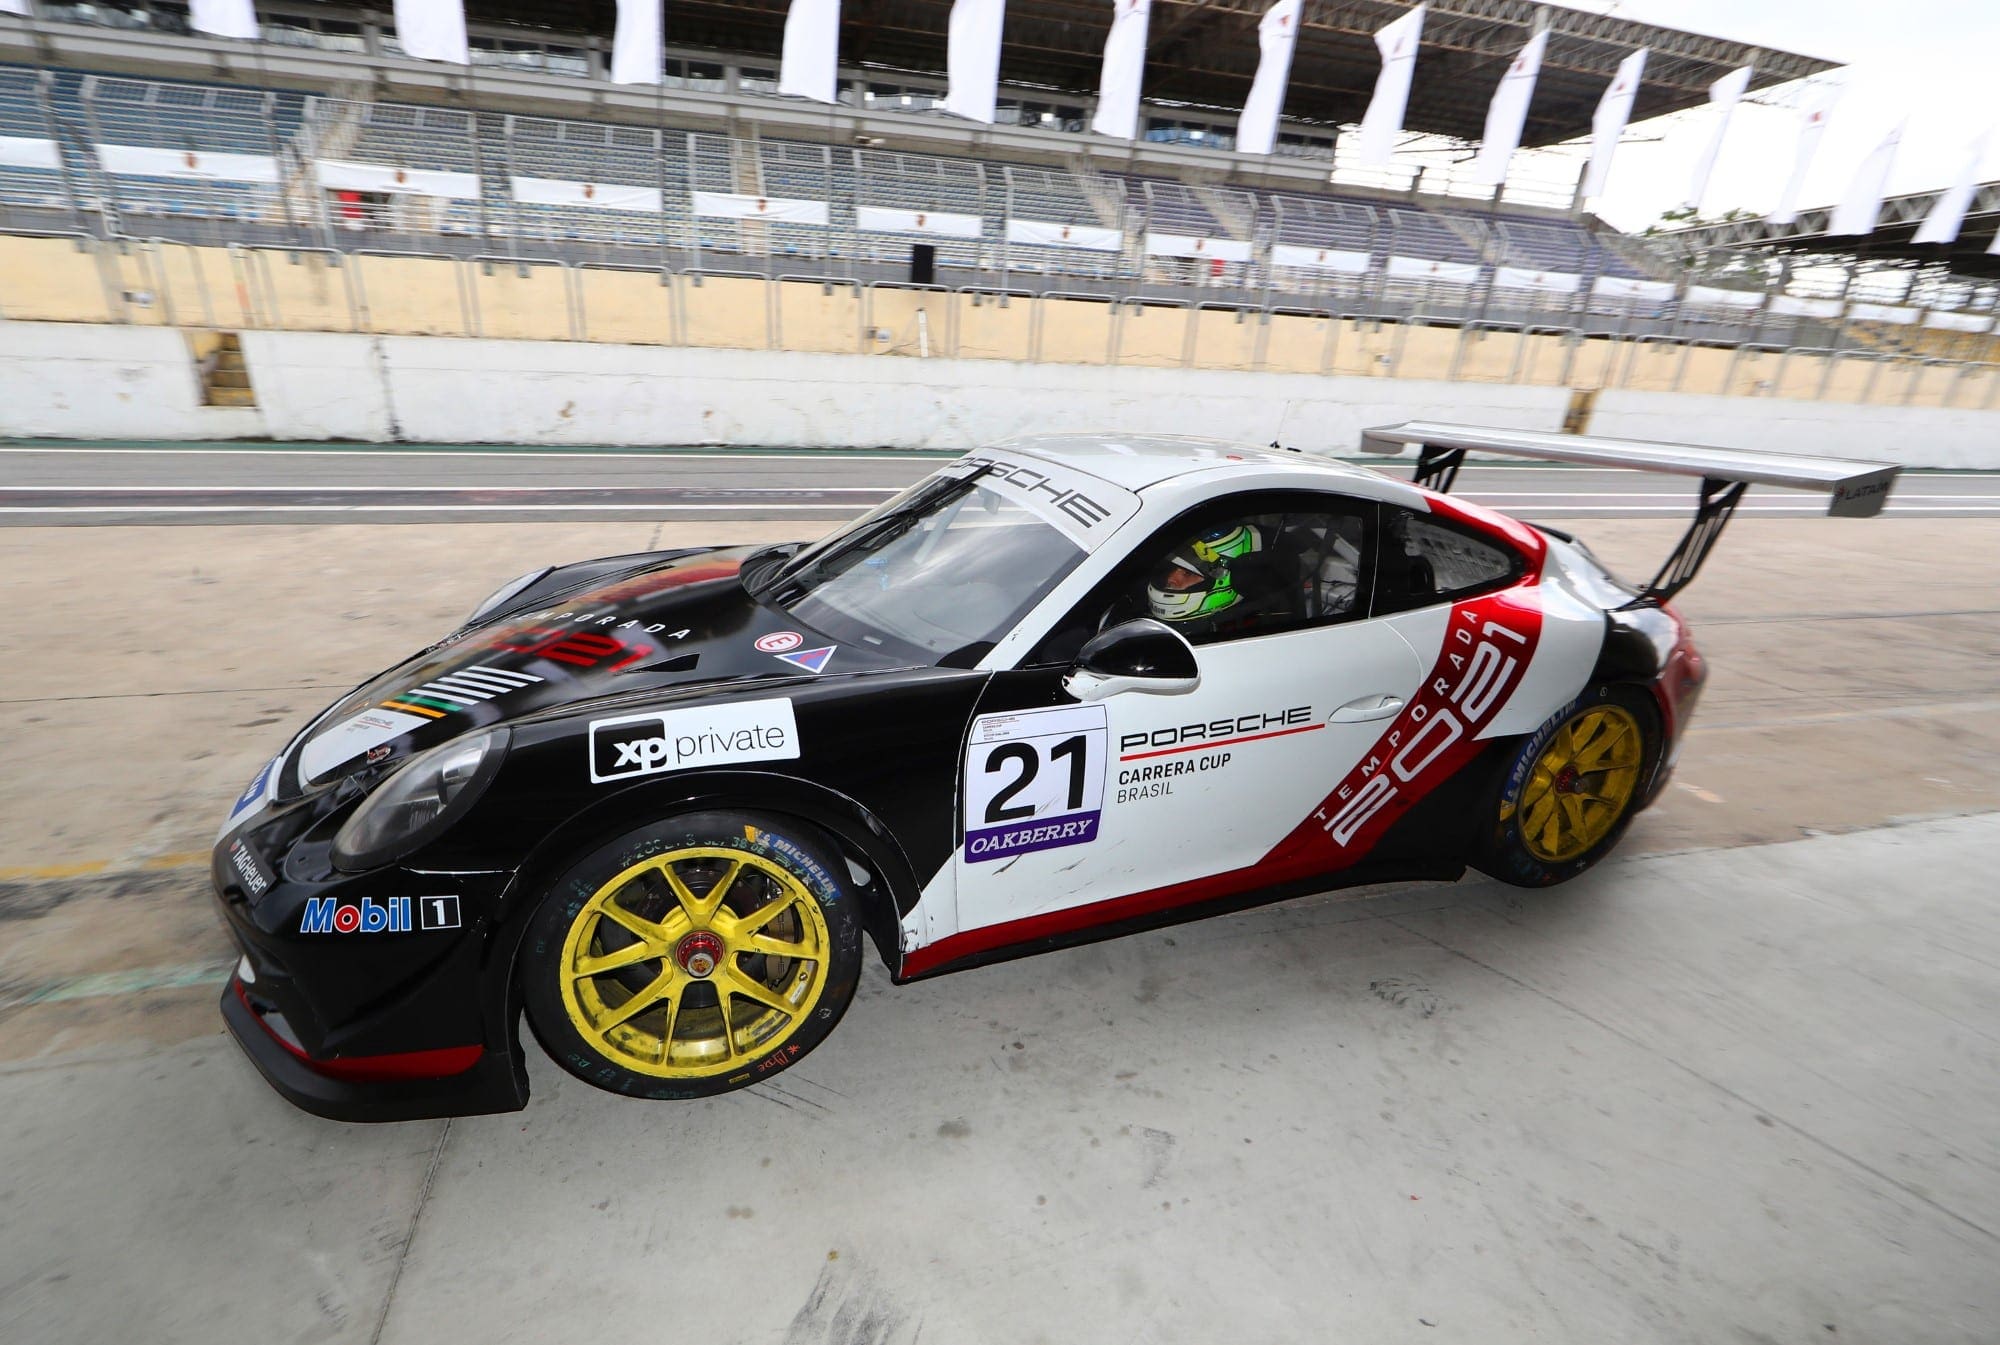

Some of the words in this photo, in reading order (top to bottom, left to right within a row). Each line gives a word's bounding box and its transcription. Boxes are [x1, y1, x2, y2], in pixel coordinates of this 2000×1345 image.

[1120, 705, 1312, 752] PORSCHE
[1313, 609, 1478, 821] TEMPORADA
[1324, 621, 1527, 847] 2021
[676, 724, 785, 764] private
[984, 735, 1087, 824] 21
[1119, 759, 1195, 785] CARRERA
[1199, 753, 1231, 771] CUP
[1117, 781, 1173, 804] BRASIL
[970, 819, 1093, 854] OAKBERRY
[773, 839, 837, 893] MICHELIN
[300, 897, 412, 934] Mobil
